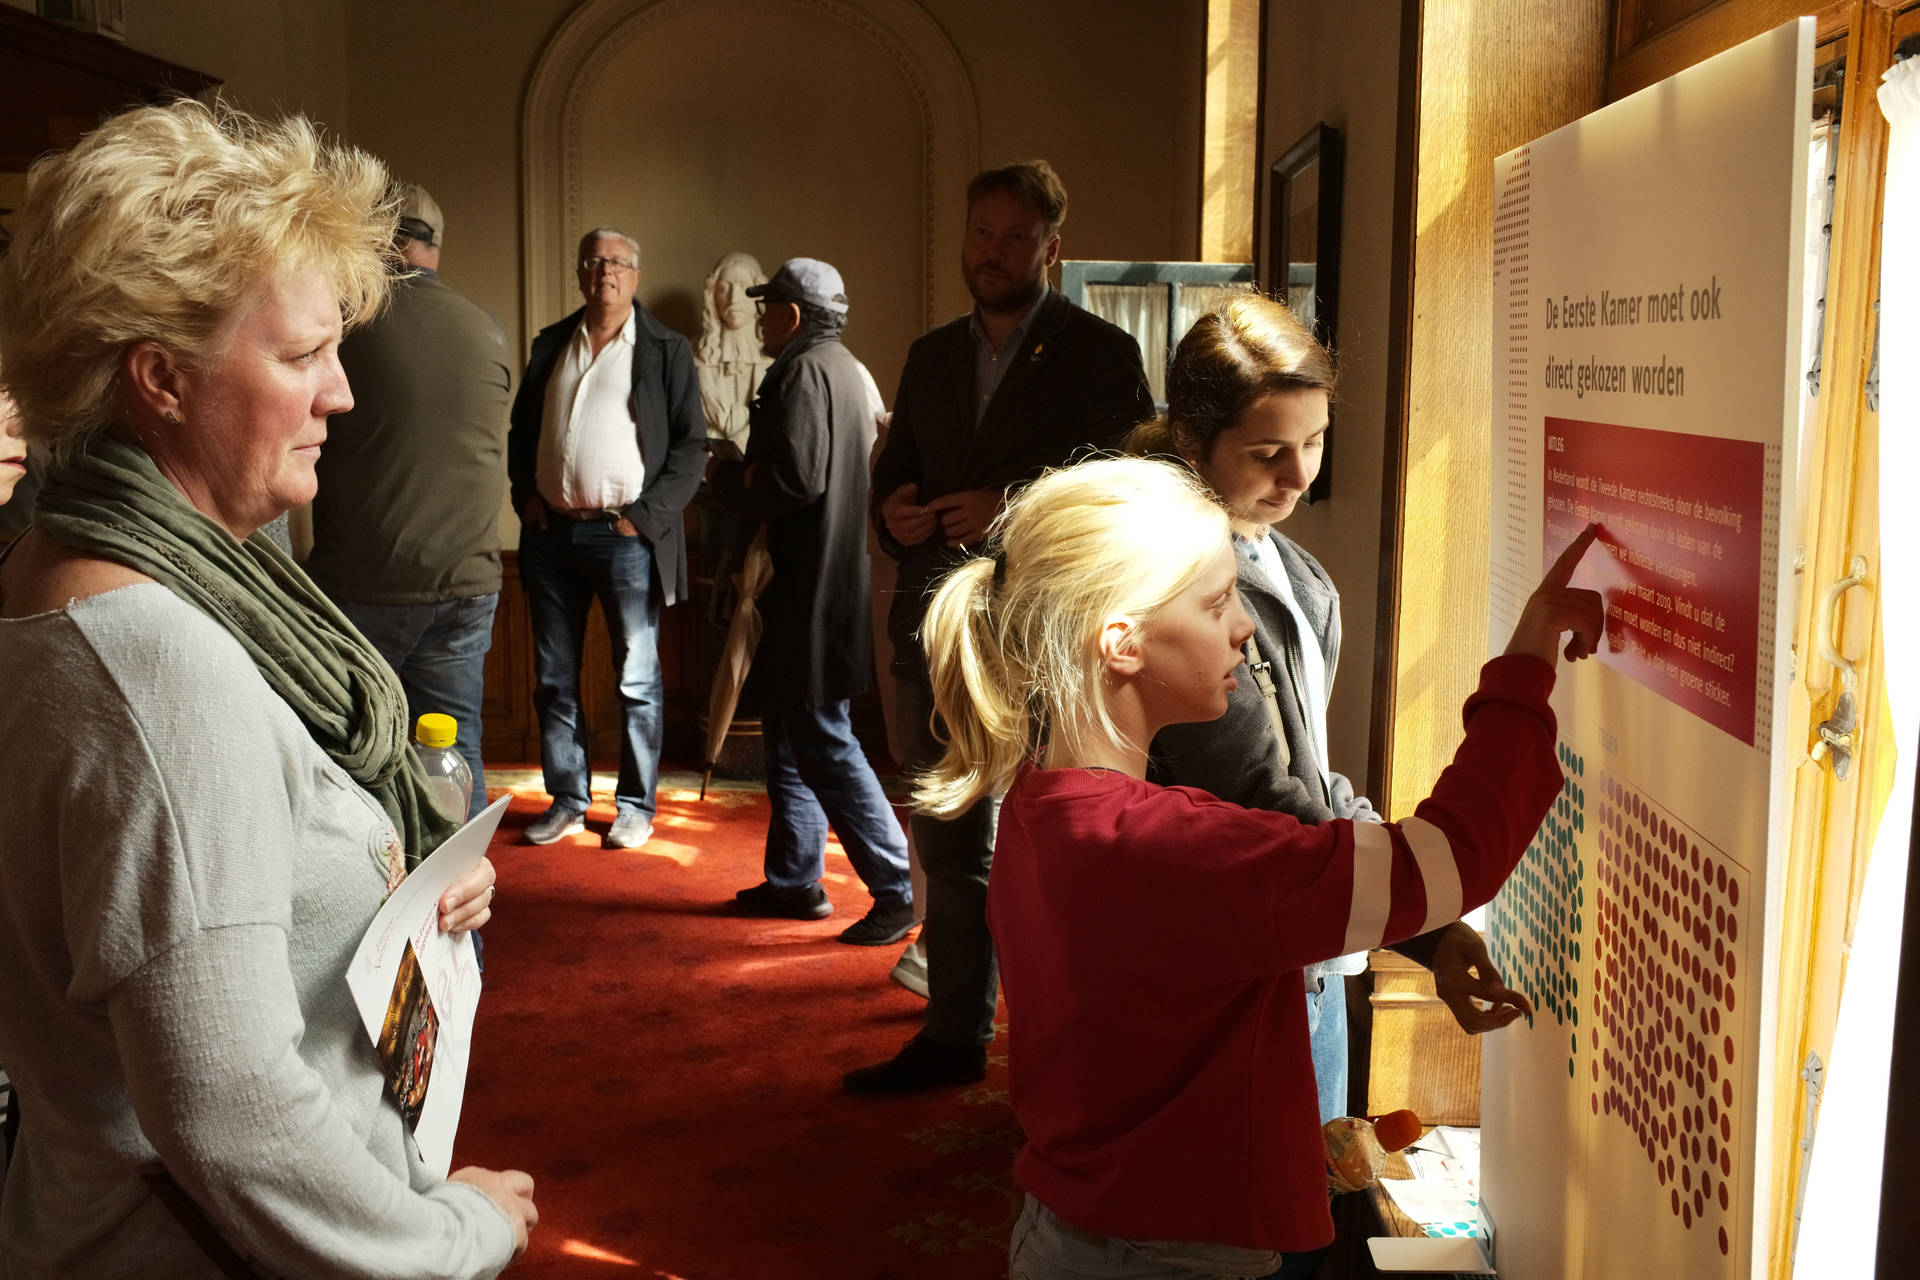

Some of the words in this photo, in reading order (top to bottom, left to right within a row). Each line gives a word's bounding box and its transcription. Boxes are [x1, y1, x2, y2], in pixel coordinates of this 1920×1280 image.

[1546, 297, 1558, 330] De
[1562, 295, 1596, 329] Eerste
[1601, 290, 1643, 327] Kamer
[1647, 280, 1685, 324] moet
[1691, 274, 1722, 321] ook
[1545, 355, 1574, 391] direct
[1577, 355, 1626, 399] gekozen
[1632, 355, 1685, 397] worden
[1547, 435, 1564, 453] UITLEG
[1553, 467, 1575, 488] Nederland
[1576, 472, 1590, 491] wordt
[1590, 475, 1598, 493] de
[1598, 477, 1618, 498] Tweede
[1619, 482, 1637, 502] Kamer
[1638, 487, 1674, 512] rechtstreeks
[1676, 495, 1692, 516] door
[1693, 499, 1703, 520] de
[1704, 499, 1742, 534] bevolking
[1574, 500, 1590, 520] Eerste
[1676, 527, 1696, 551] leden
[1696, 538, 1711, 556] van
[1712, 539, 1724, 560] de
[1618, 546, 1628, 562] we
[1638, 585, 1655, 605] maart
[1656, 592, 1674, 615] 2019.
[1674, 595, 1693, 620] Vindt
[1694, 607, 1700, 622] u
[1700, 605, 1714, 629] dat
[1714, 611, 1726, 633] de
[1624, 607, 1638, 628] moet
[1639, 616, 1662, 639] worden
[1662, 627, 1672, 644] en
[1672, 627, 1687, 651] dus
[1687, 635, 1702, 659] niet
[1702, 641, 1736, 673] indirect?
[1653, 652, 1666, 673] dan
[1666, 661, 1679, 680] een
[1679, 669, 1704, 693] groene
[1704, 680, 1732, 708] sticker.
